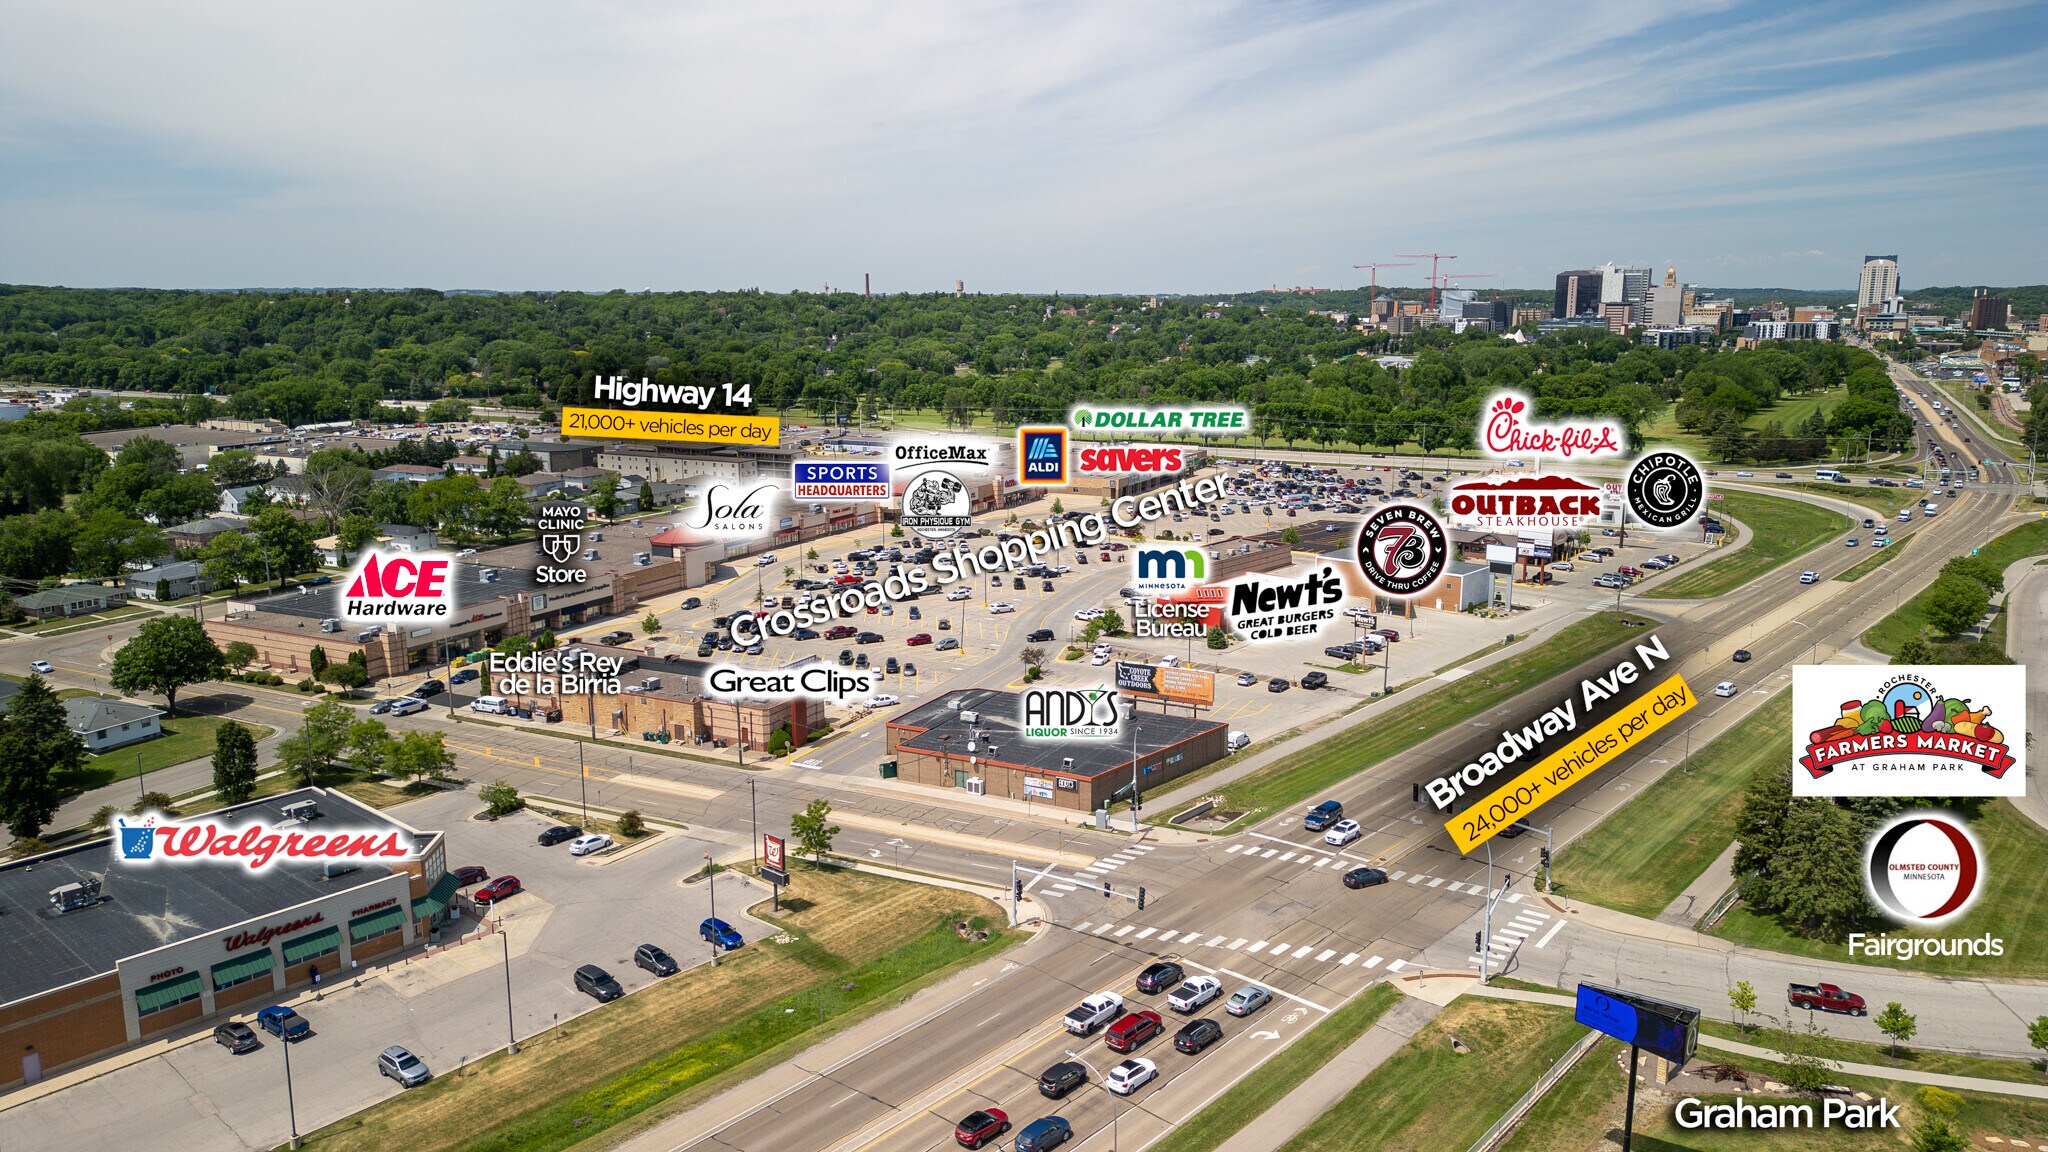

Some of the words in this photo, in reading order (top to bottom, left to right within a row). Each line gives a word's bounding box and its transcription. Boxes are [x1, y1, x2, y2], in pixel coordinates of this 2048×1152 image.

[1118, 679, 1152, 690] OUTDOORS
[351, 897, 397, 917] PHARMACY
[223, 912, 325, 952] Walgreens
[150, 966, 184, 982] PHOTO
